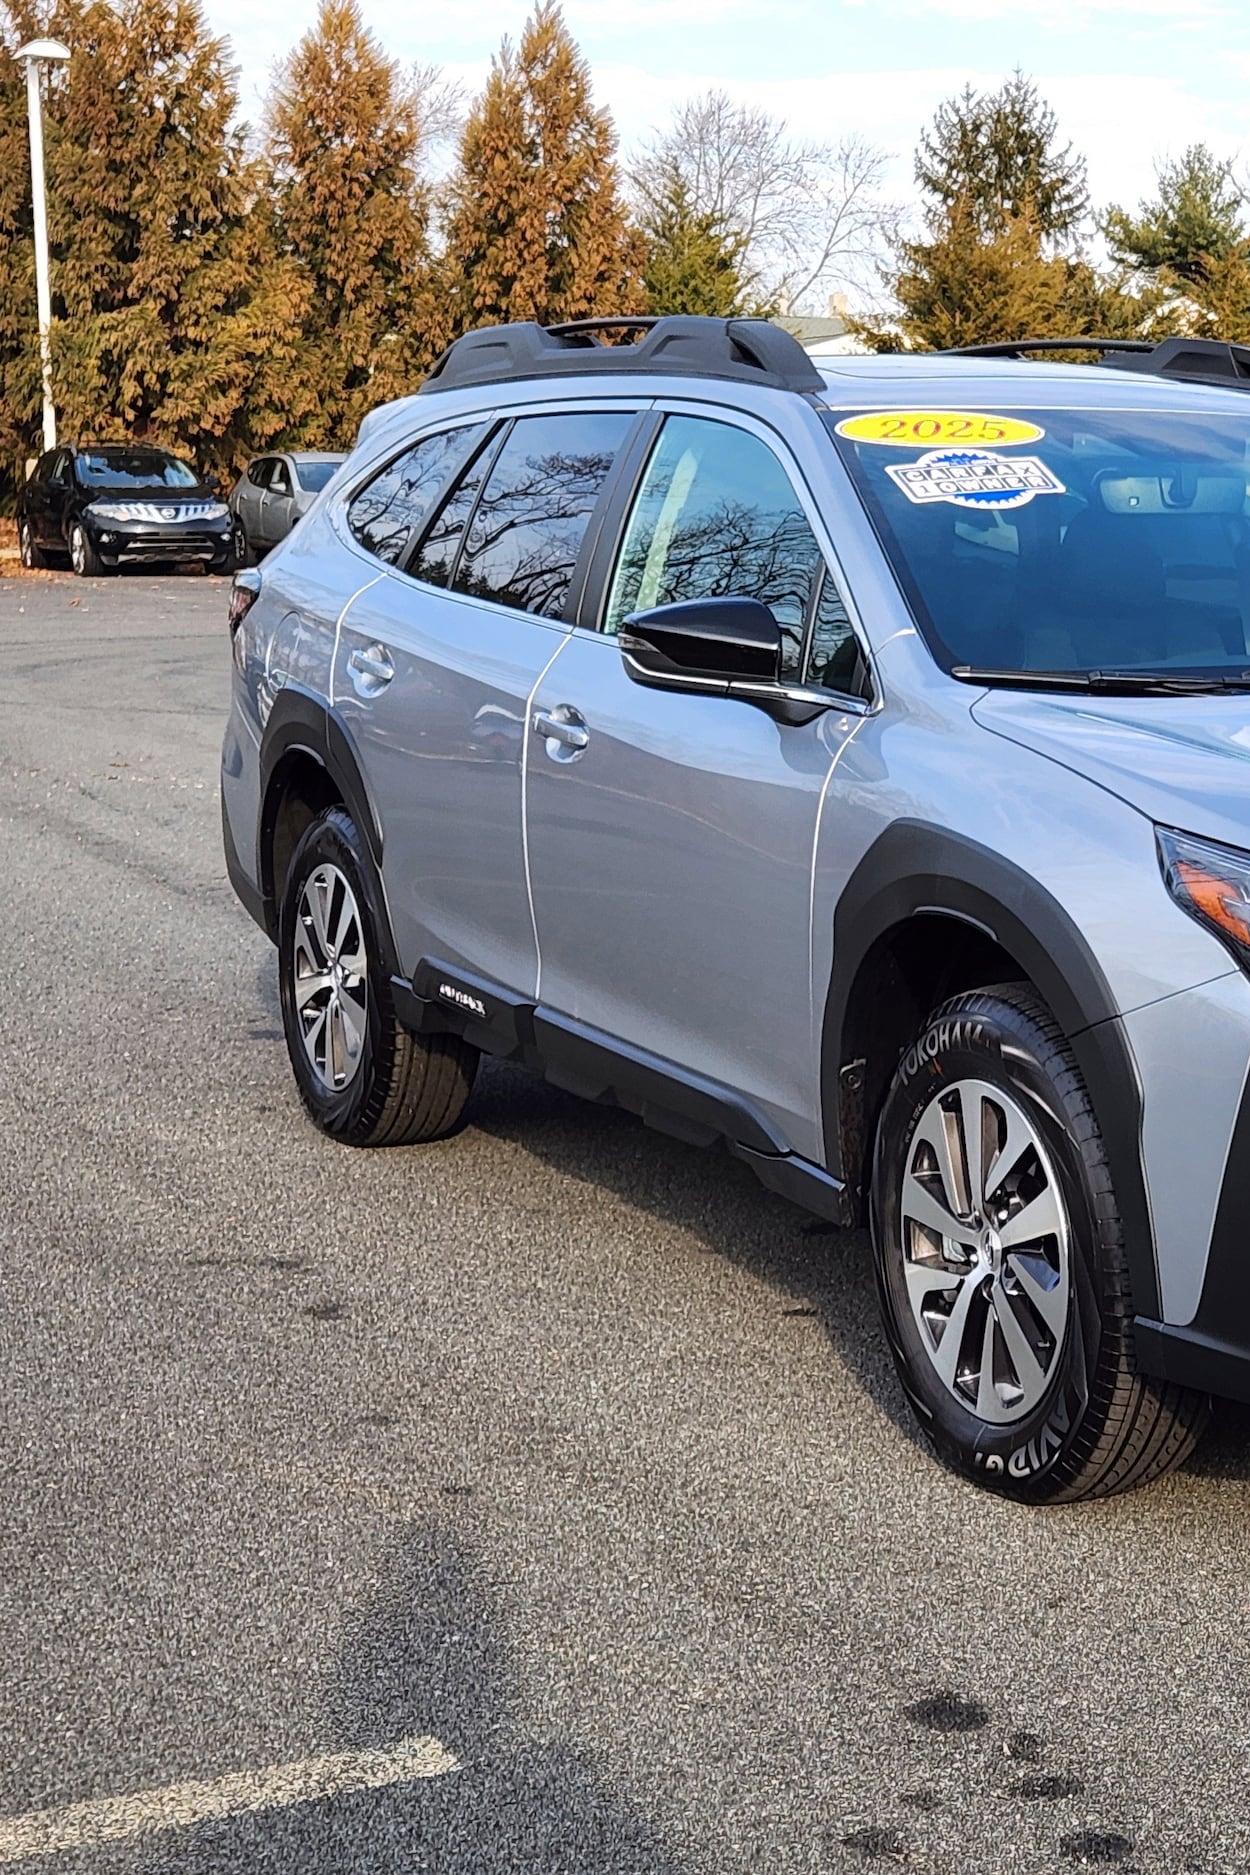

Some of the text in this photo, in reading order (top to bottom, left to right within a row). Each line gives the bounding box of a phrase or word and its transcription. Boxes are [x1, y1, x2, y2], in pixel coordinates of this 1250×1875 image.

[880, 418, 1008, 440] 2025
[902, 463, 1035, 482] CARFAX
[937, 476, 1049, 493] OWNER
